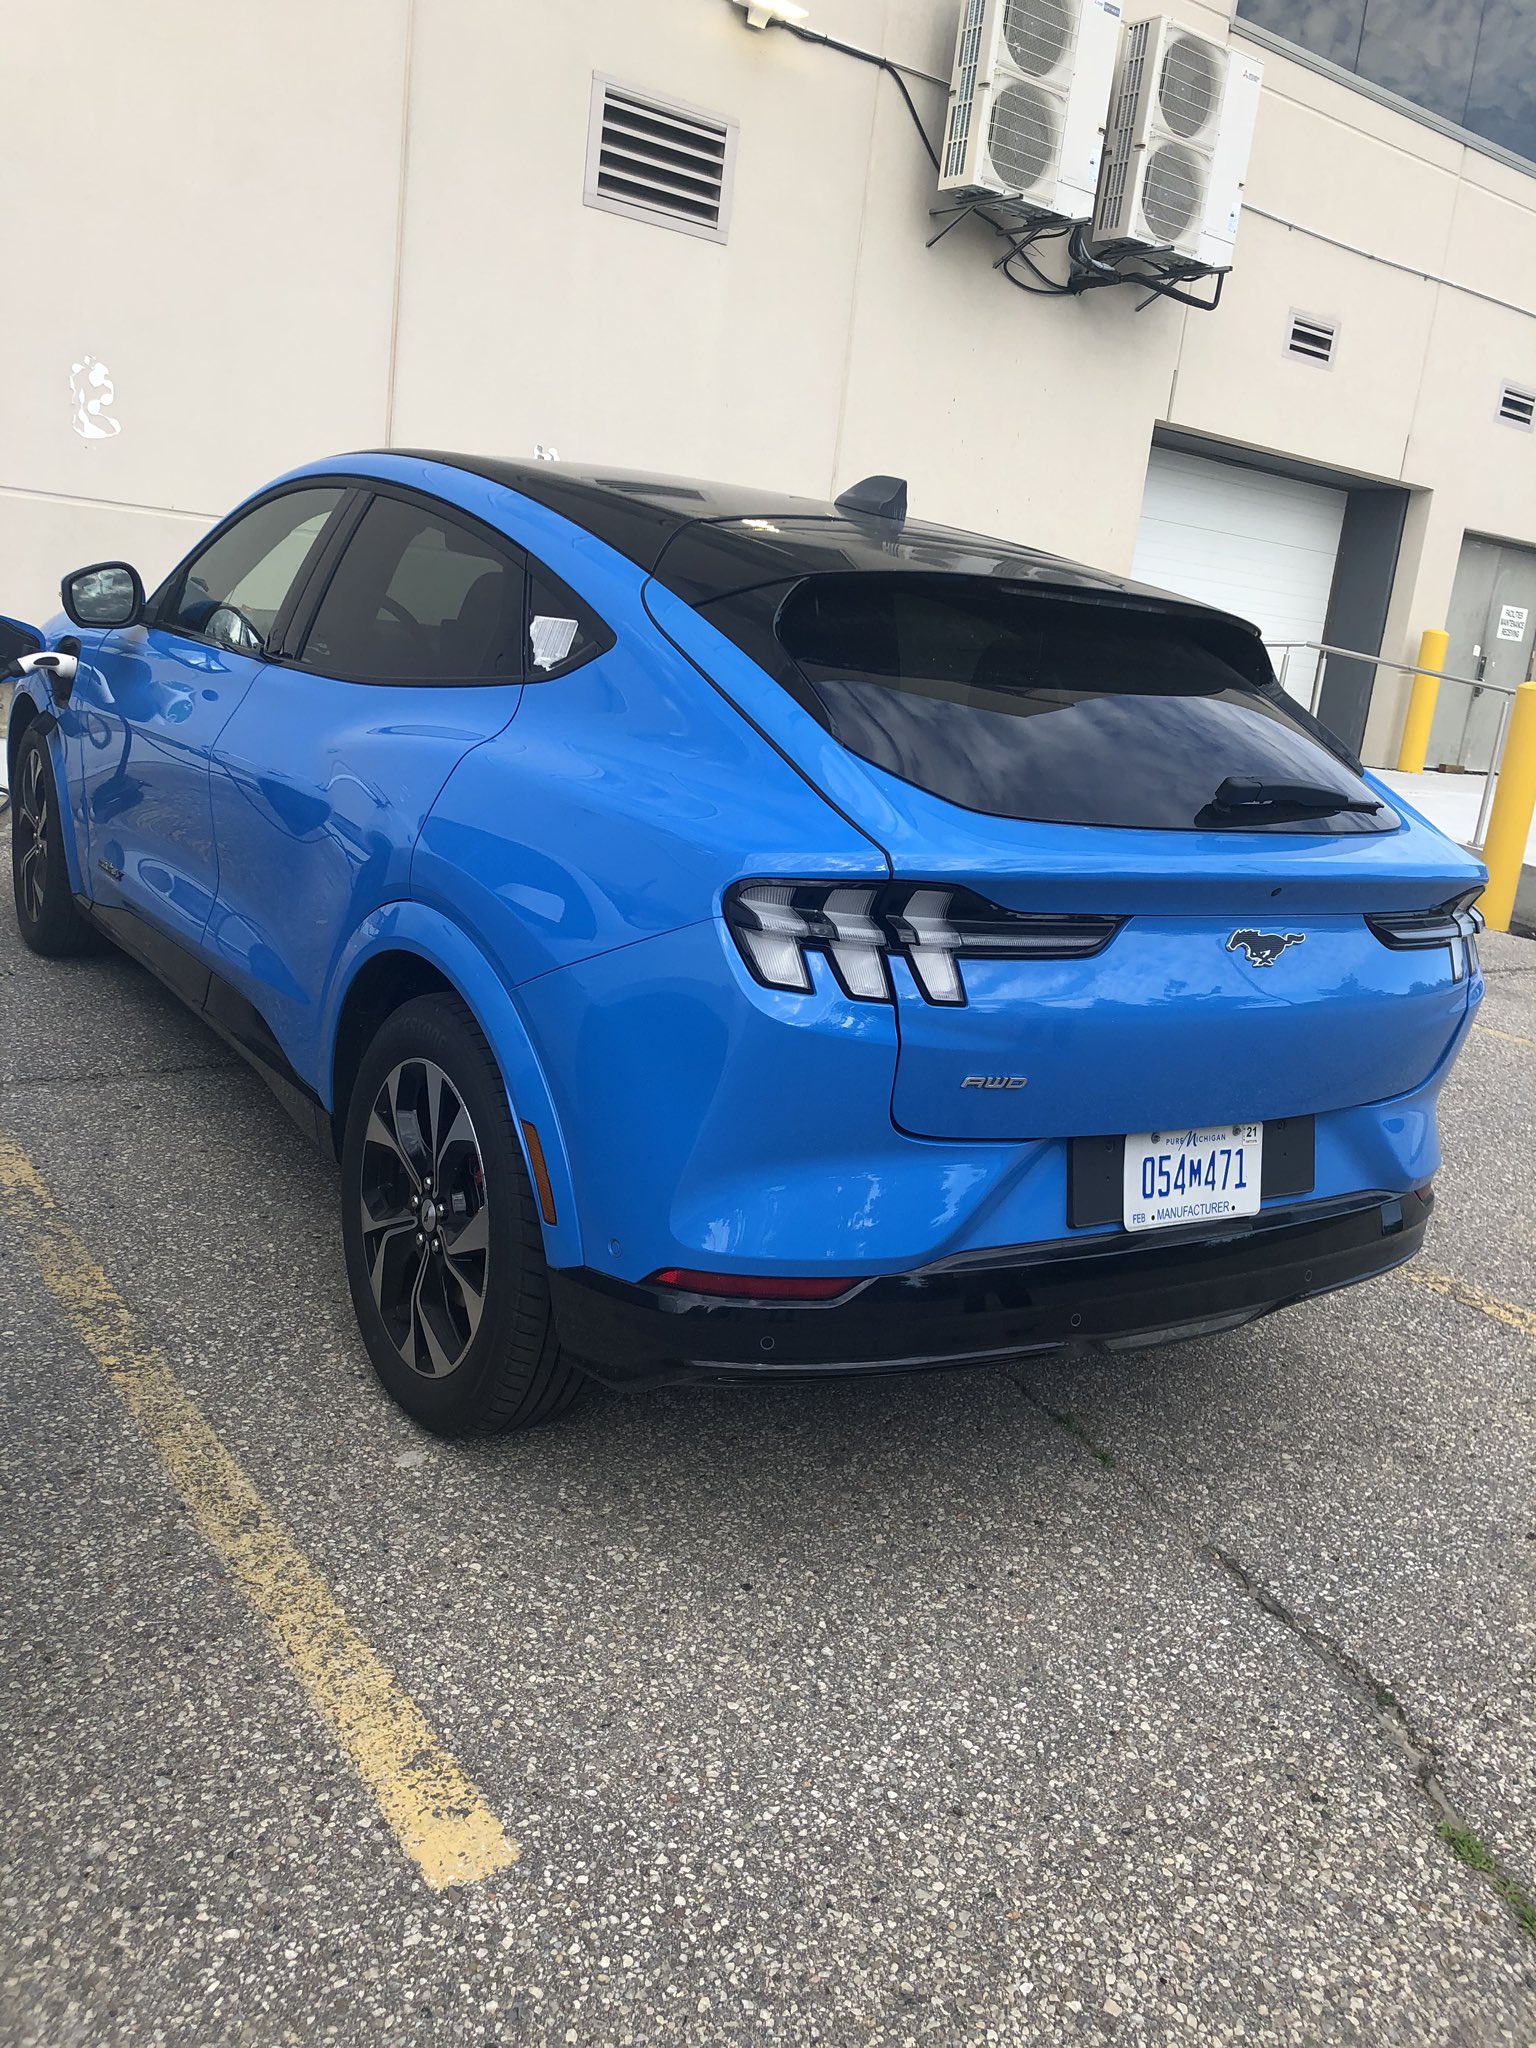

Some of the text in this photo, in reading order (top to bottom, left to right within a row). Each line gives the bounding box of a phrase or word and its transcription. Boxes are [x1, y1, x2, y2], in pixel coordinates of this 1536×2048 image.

[960, 1076, 1028, 1089] AWD
[1165, 1130, 1226, 1151] PURE MICHIGAN
[1246, 1126, 1257, 1138] 21
[1142, 1148, 1247, 1200] 054M471
[1132, 1201, 1230, 1224] FEB MANUFACTURER
